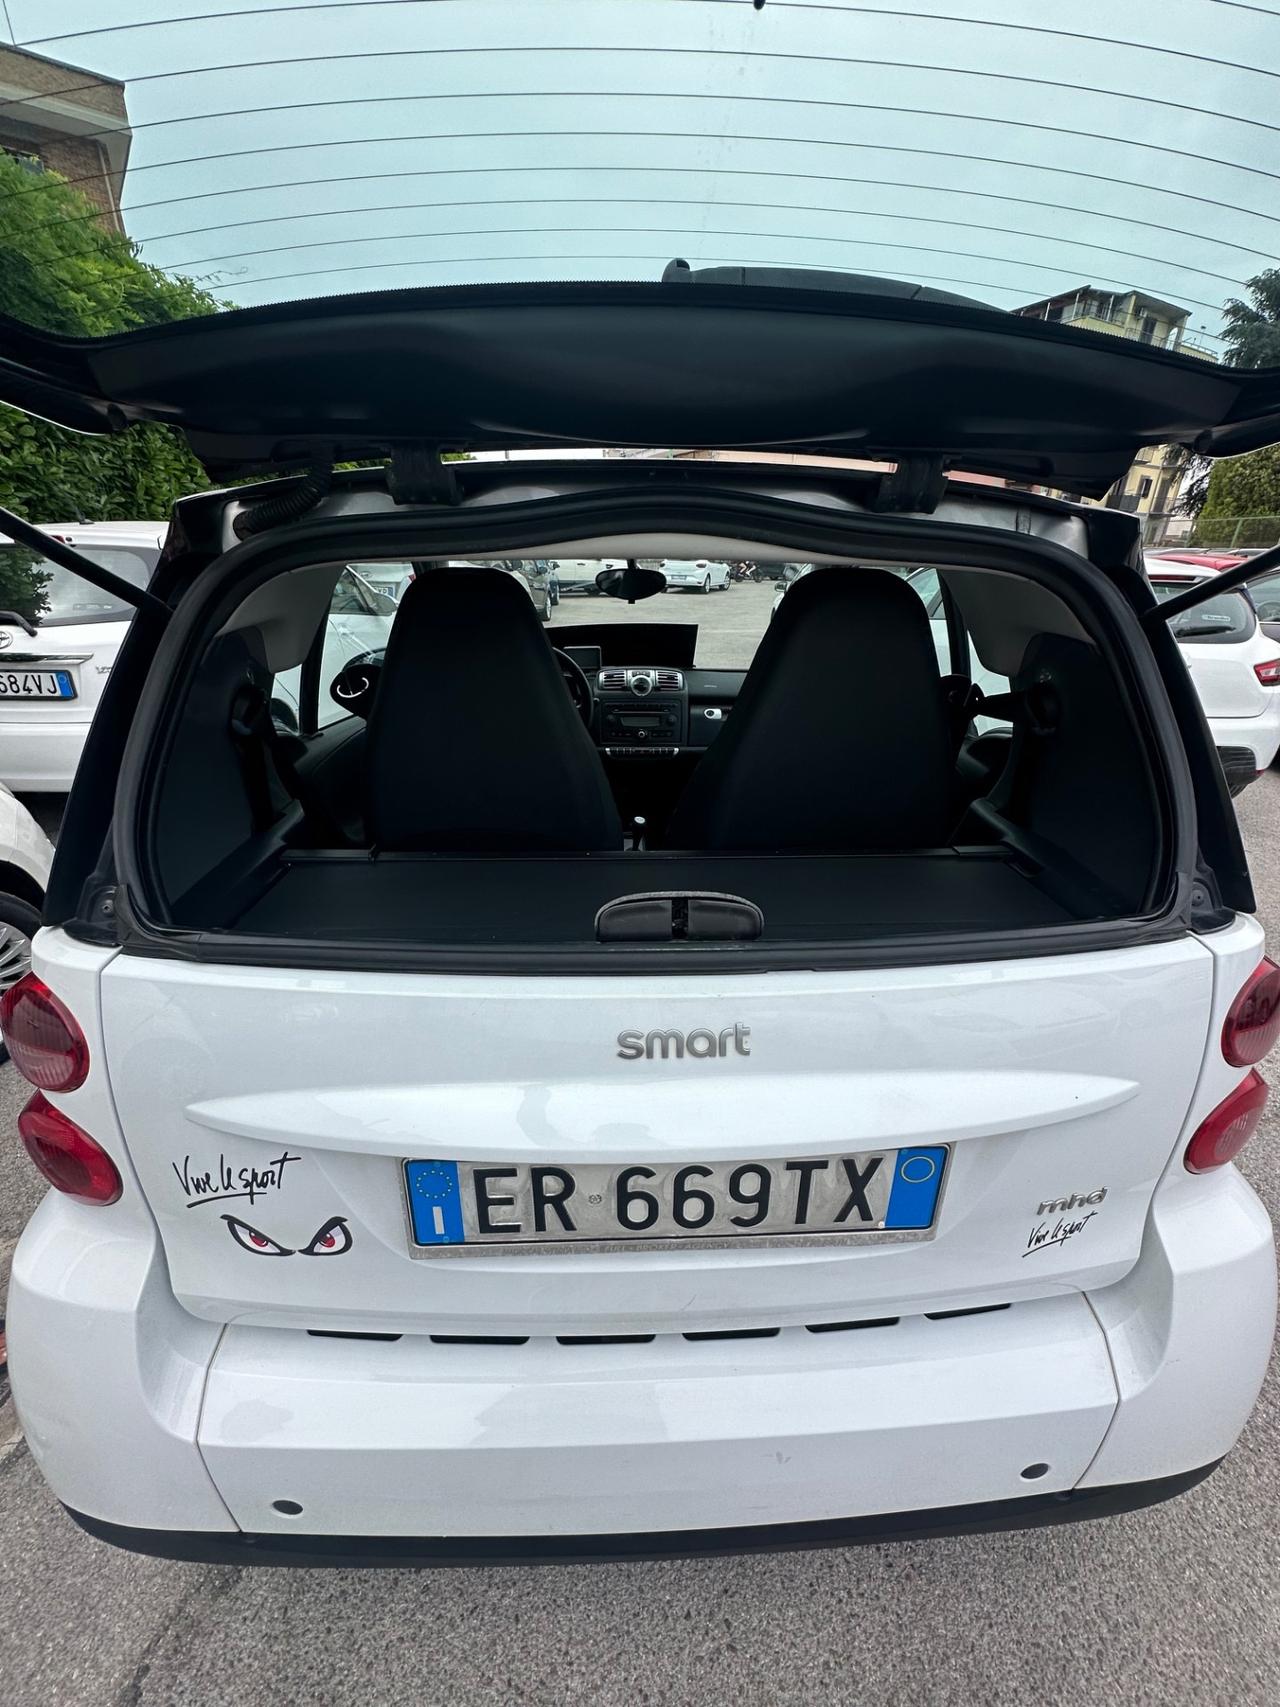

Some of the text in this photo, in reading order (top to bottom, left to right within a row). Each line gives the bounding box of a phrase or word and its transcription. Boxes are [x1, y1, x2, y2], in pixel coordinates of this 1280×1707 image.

[617, 1021, 752, 1060] smart
[238, 1151, 302, 1205] sport
[472, 1157, 884, 1234] ER 669TX
[1036, 1186, 1108, 1216] mhd
[1061, 1210, 1099, 1247] sport
